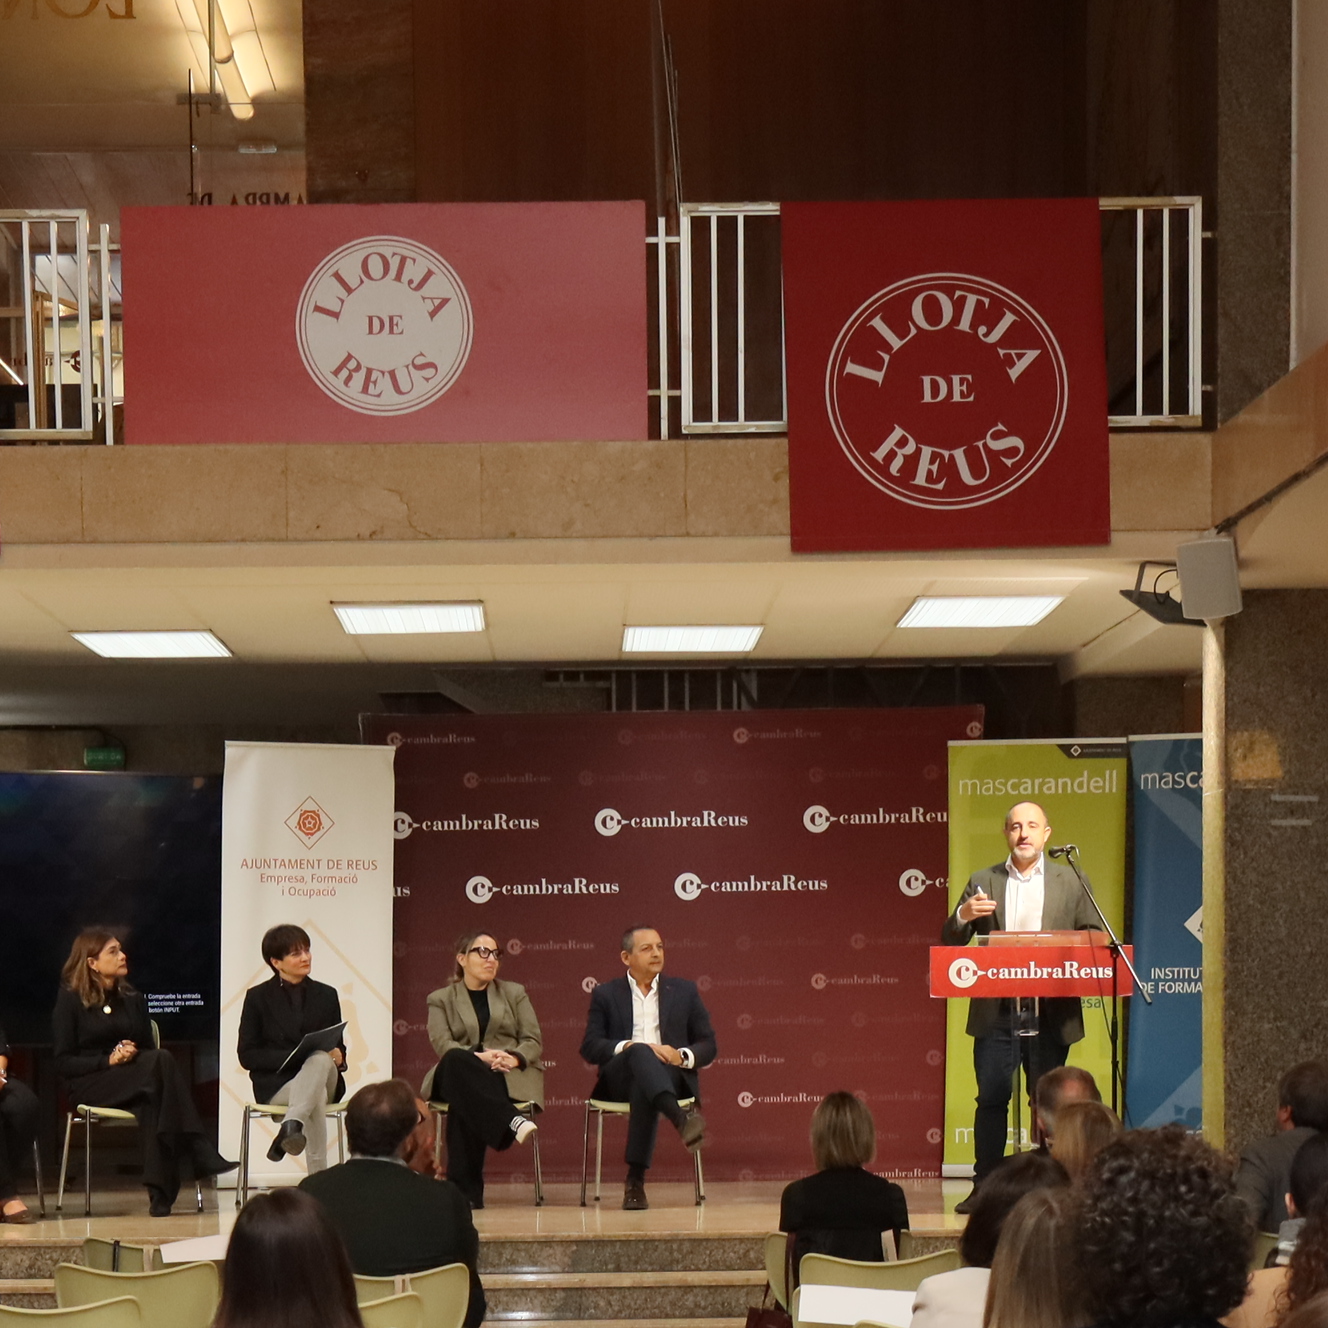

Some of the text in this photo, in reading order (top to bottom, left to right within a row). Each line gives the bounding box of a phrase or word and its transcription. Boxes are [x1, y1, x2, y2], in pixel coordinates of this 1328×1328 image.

[313, 250, 451, 322] LLOTJA
[366, 314, 405, 336] DE
[844, 289, 1043, 388] LLOTJA
[330, 350, 440, 399] REUS
[919, 374, 975, 404] DE
[869, 421, 1026, 492] REUS
[958, 769, 1118, 795] mascarandell
[422, 813, 540, 831] cambraReus
[630, 809, 749, 828] cambraReus
[839, 806, 948, 825] cambraReu
[240, 858, 378, 871] AJUNTAMENT DE REUS
[260, 872, 359, 886] Empresa, Formació
[501, 877, 619, 896] cambraReus
[710, 874, 828, 892] cambraReus
[288, 886, 337, 899] Ocupació
[987, 961, 1114, 980] cambraReus
[1150, 967, 1203, 980] INSTITU
